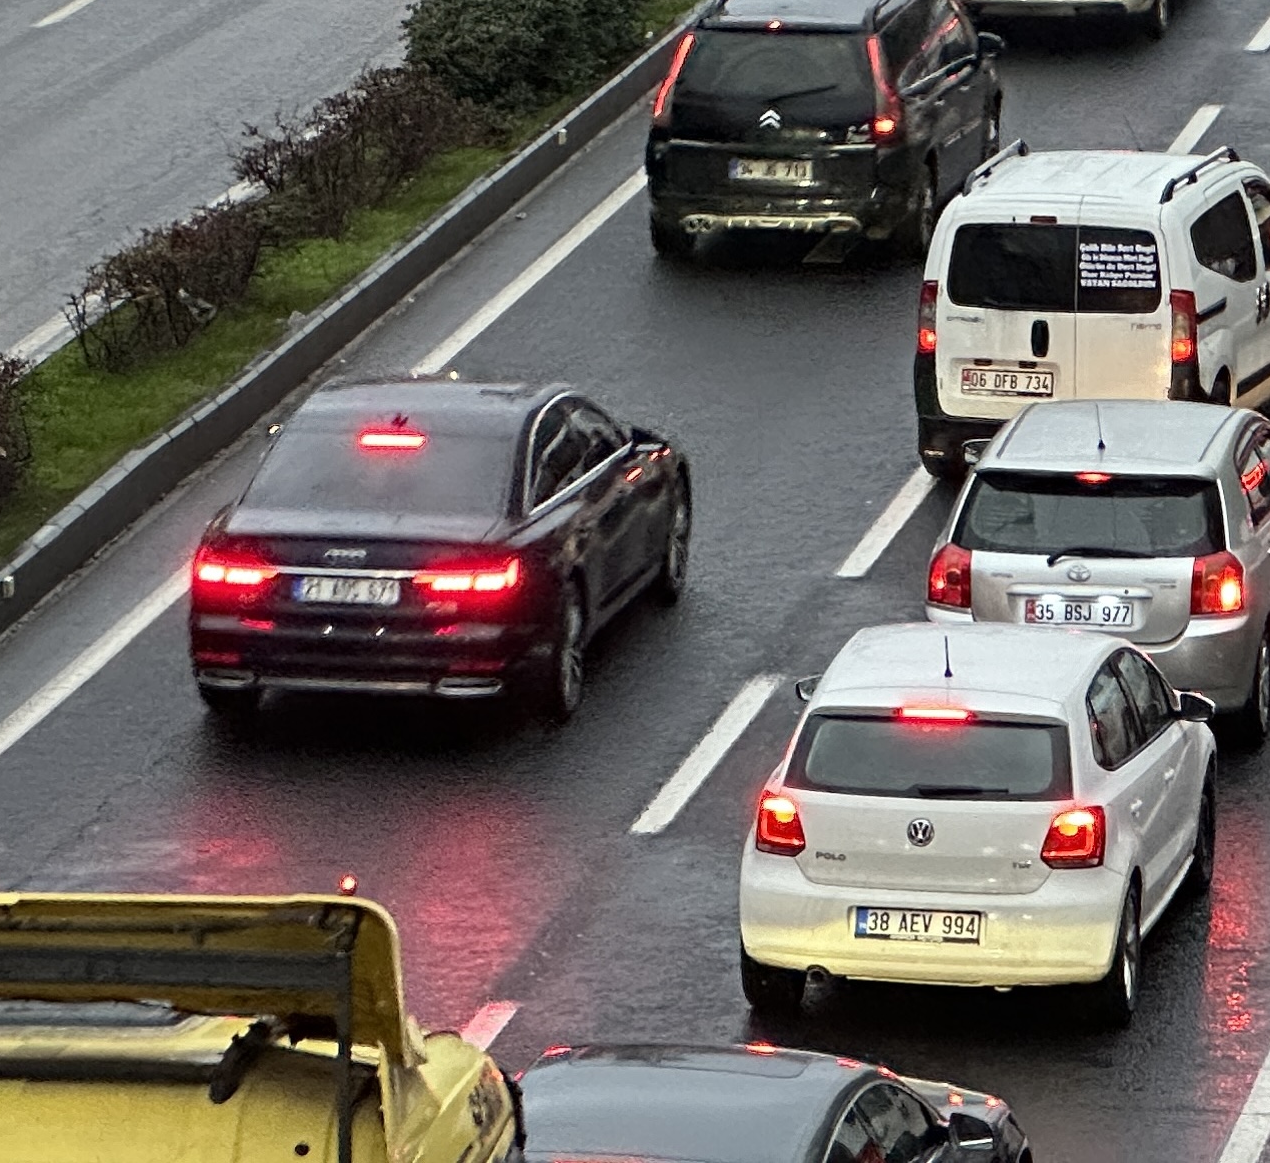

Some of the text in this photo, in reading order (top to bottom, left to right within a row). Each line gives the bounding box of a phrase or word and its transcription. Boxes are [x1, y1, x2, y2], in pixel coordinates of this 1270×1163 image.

[971, 372, 1049, 391] 06 DFB 734
[1035, 603, 1130, 622] 35 BSJ 977
[815, 850, 847, 862] POLO
[868, 911, 976, 936] 38 AEV 994
